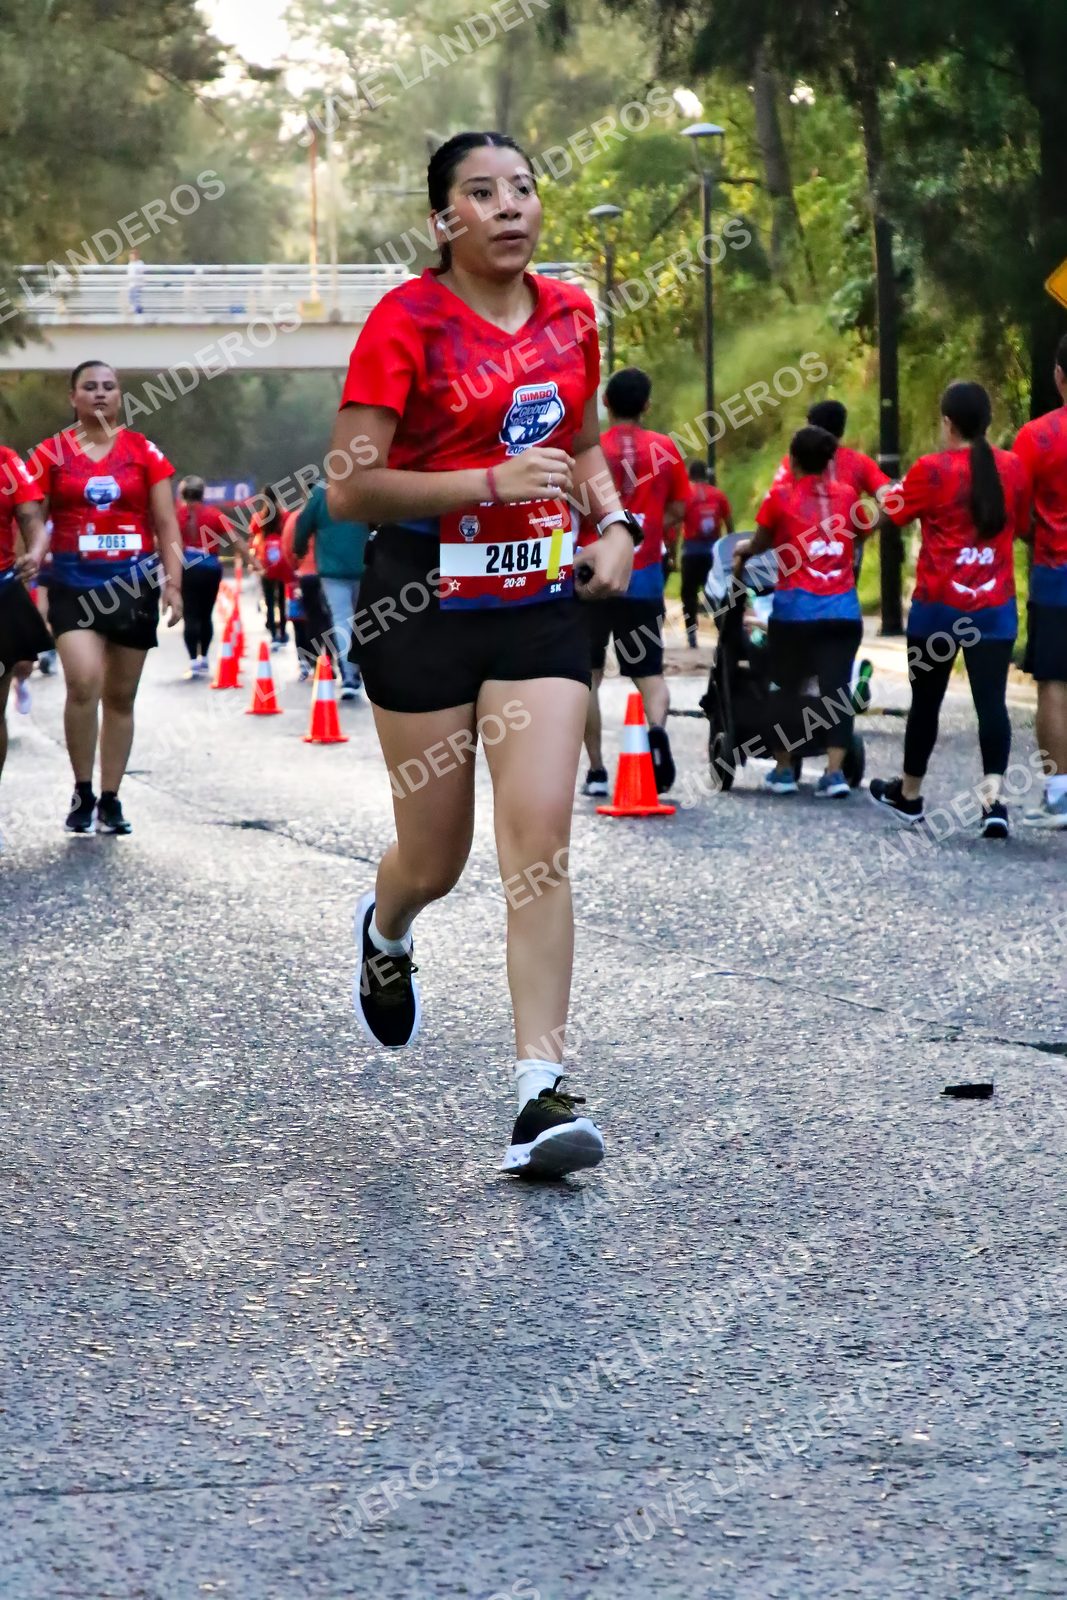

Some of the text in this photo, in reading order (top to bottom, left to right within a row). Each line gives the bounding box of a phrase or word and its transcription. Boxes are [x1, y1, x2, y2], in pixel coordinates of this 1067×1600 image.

[520, 389, 553, 403] BIMBO
[507, 444, 529, 455] 202
[97, 535, 127, 549] 2063
[486, 541, 542, 574] 2484
